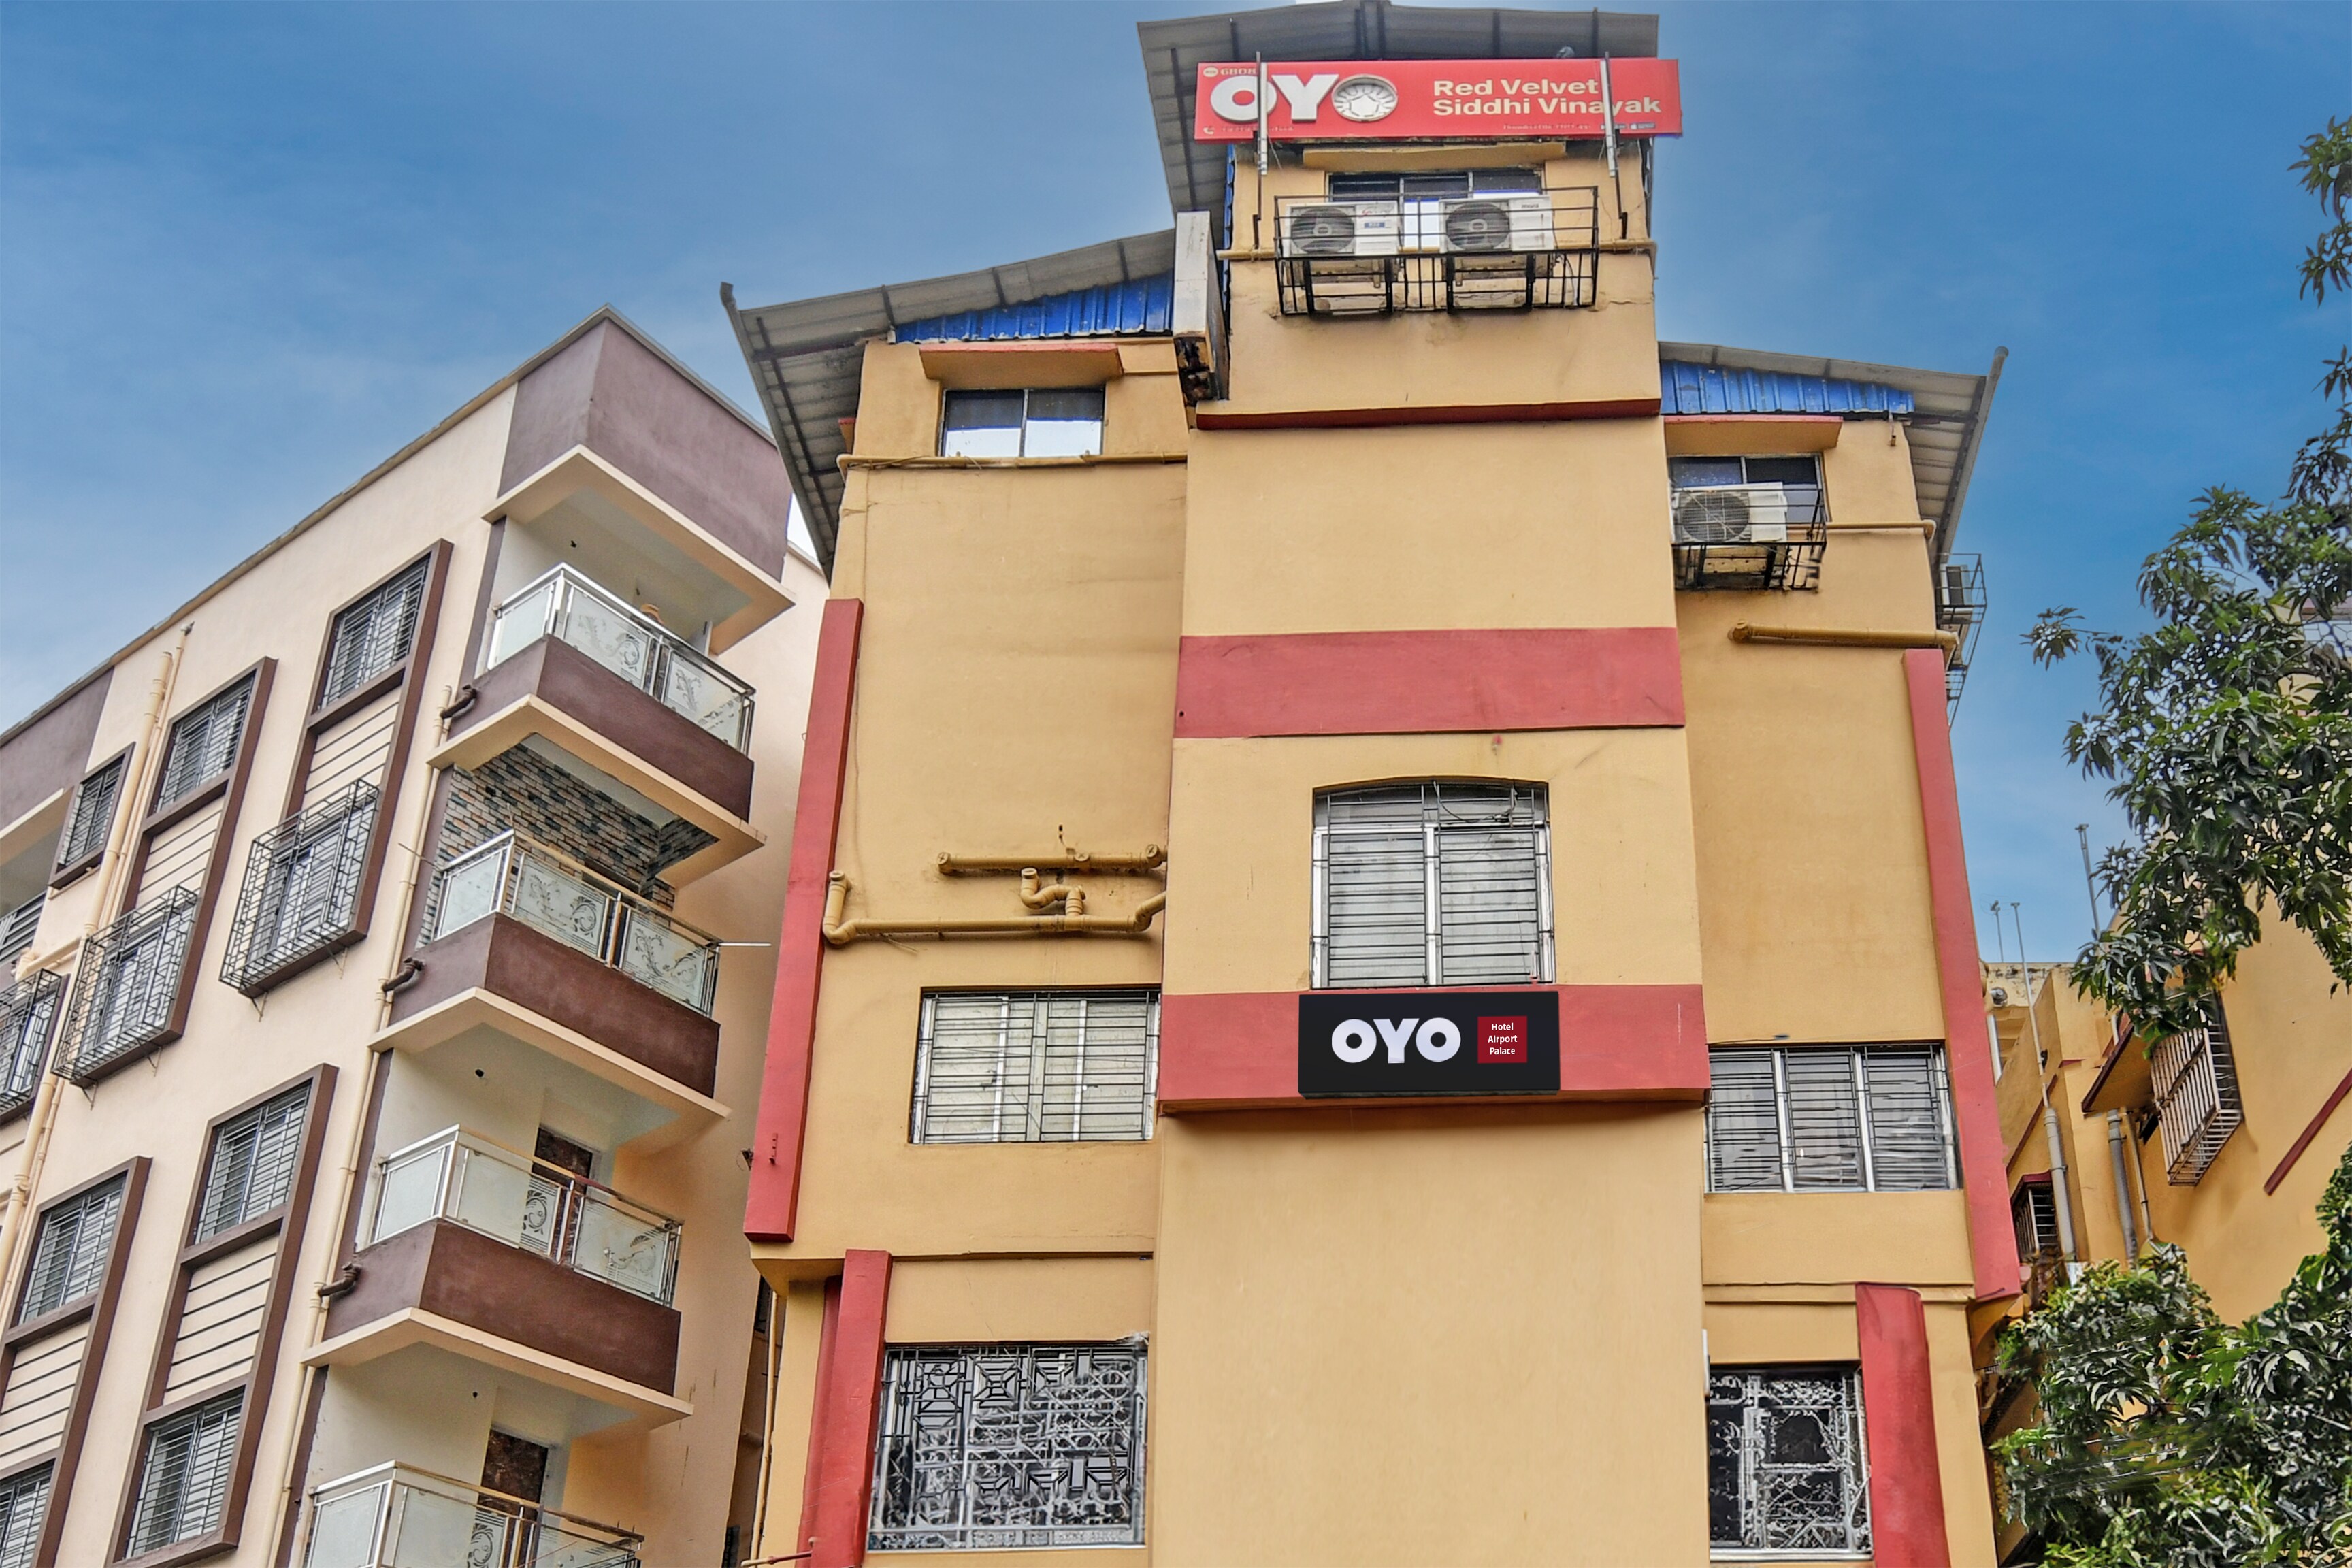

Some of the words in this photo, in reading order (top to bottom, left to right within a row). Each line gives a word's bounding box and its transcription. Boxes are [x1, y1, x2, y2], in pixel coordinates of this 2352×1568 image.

[1433, 80, 1493, 96] Red
[1501, 78, 1599, 95] Velvet
[1210, 74, 1399, 122] OYO
[1433, 98, 1531, 116] Siddhi
[1537, 97, 1661, 116] Vinayak
[1491, 1022, 1514, 1031] Hotel
[1331, 1017, 1461, 1064] OYO
[1487, 1034, 1518, 1045] Airport
[1490, 1046, 1516, 1055] Palace
